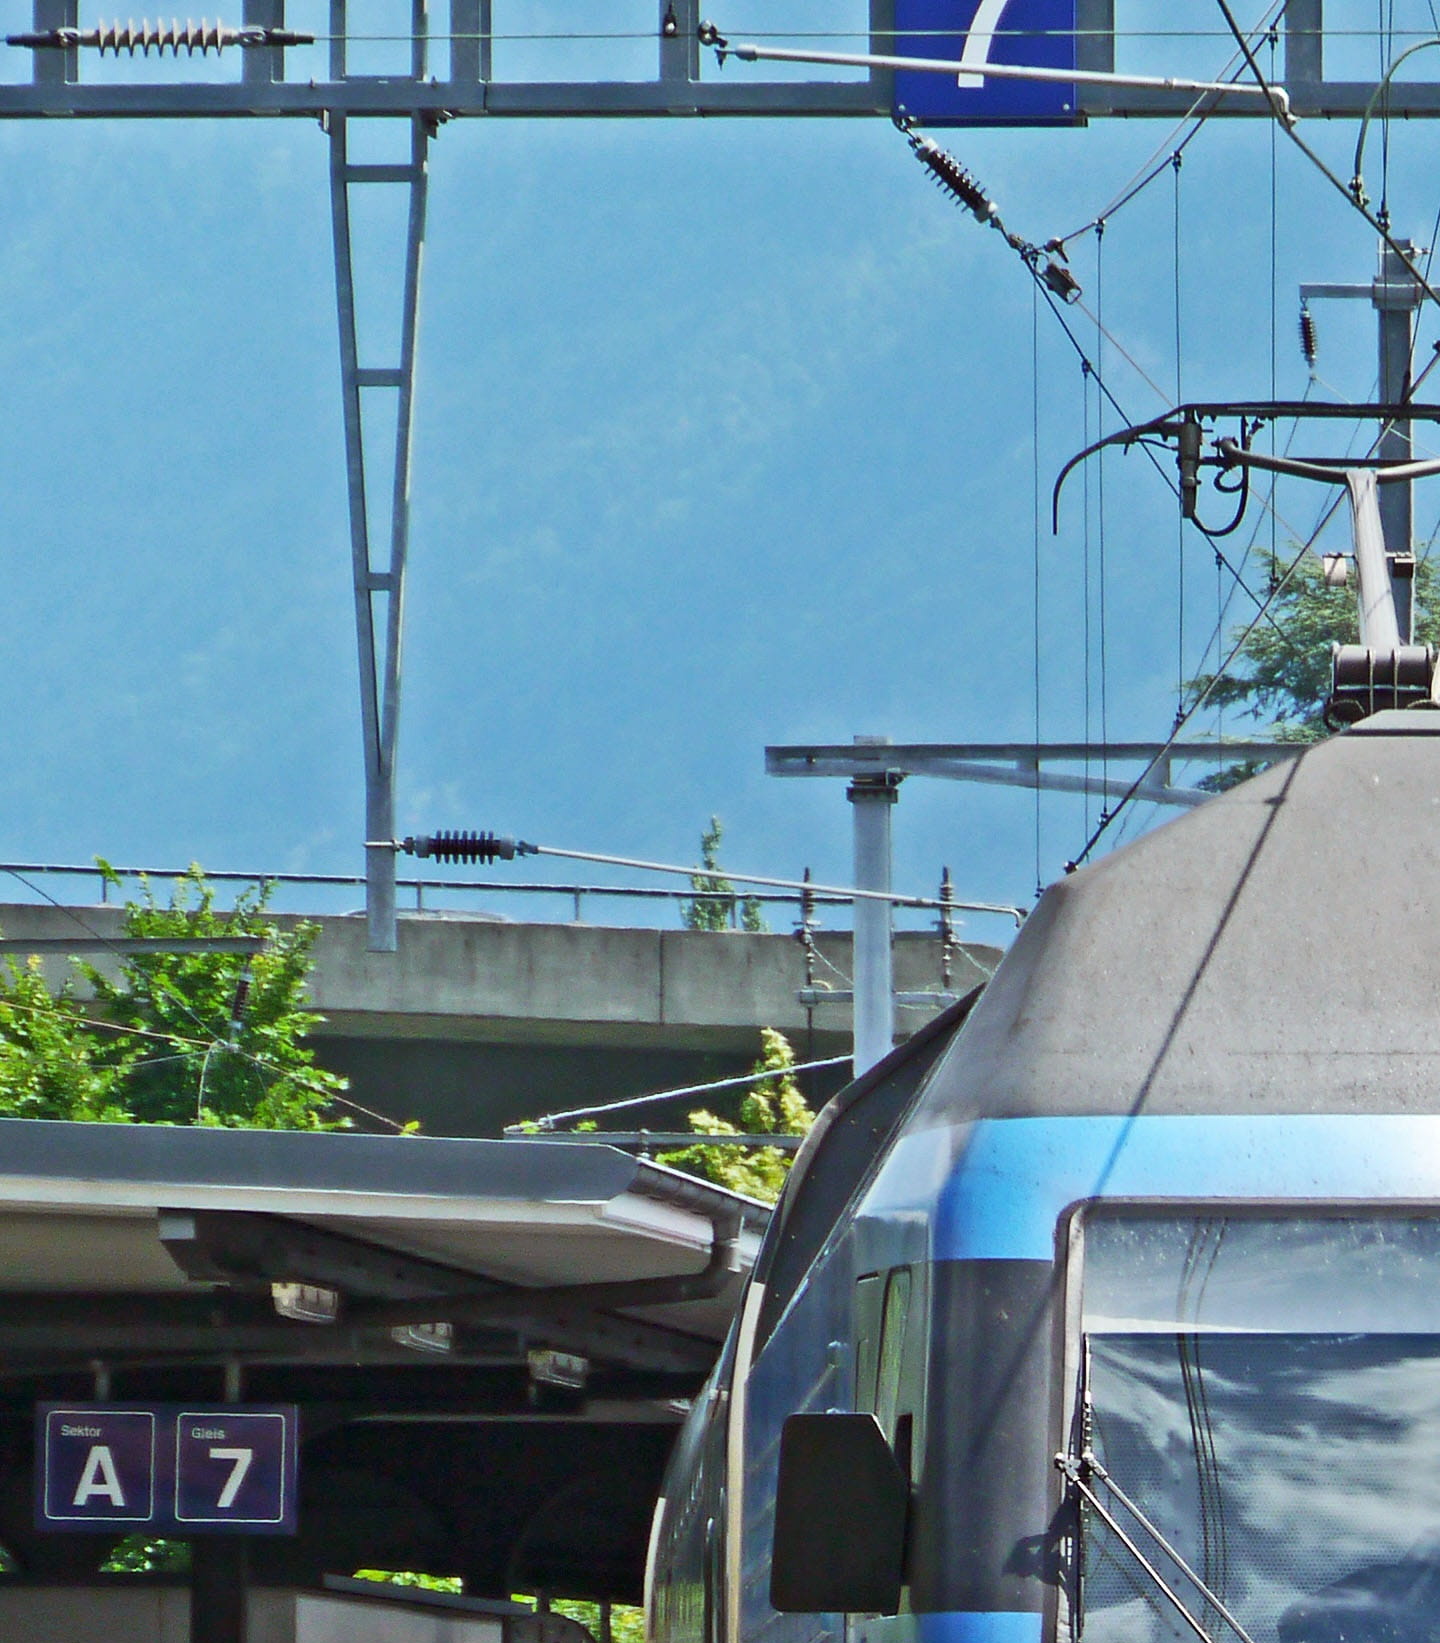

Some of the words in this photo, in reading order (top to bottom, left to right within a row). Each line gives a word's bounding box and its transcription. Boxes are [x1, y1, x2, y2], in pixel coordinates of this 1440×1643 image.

[61, 1424, 102, 1437] Sektor
[191, 1427, 226, 1440] Gleis
[72, 1445, 125, 1507] A
[209, 1447, 253, 1508] 7
